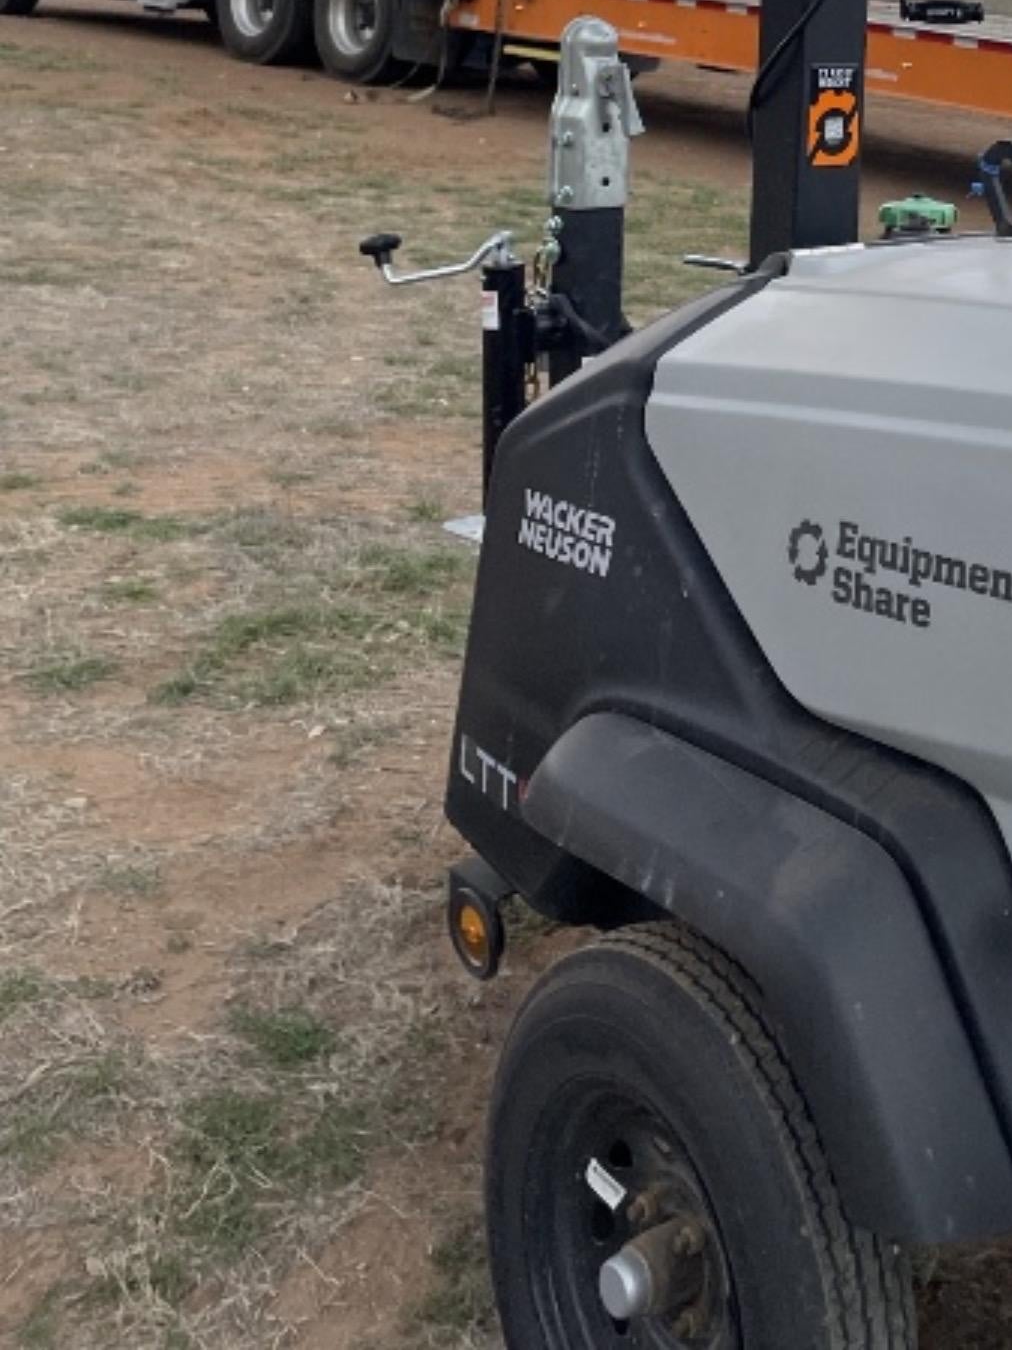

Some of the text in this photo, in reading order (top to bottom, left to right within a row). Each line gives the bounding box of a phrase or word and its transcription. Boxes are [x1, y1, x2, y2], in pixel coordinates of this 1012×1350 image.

[518, 517, 613, 577] NEUSON
[524, 488, 616, 547] WACKER
[831, 566, 932, 628] Share
